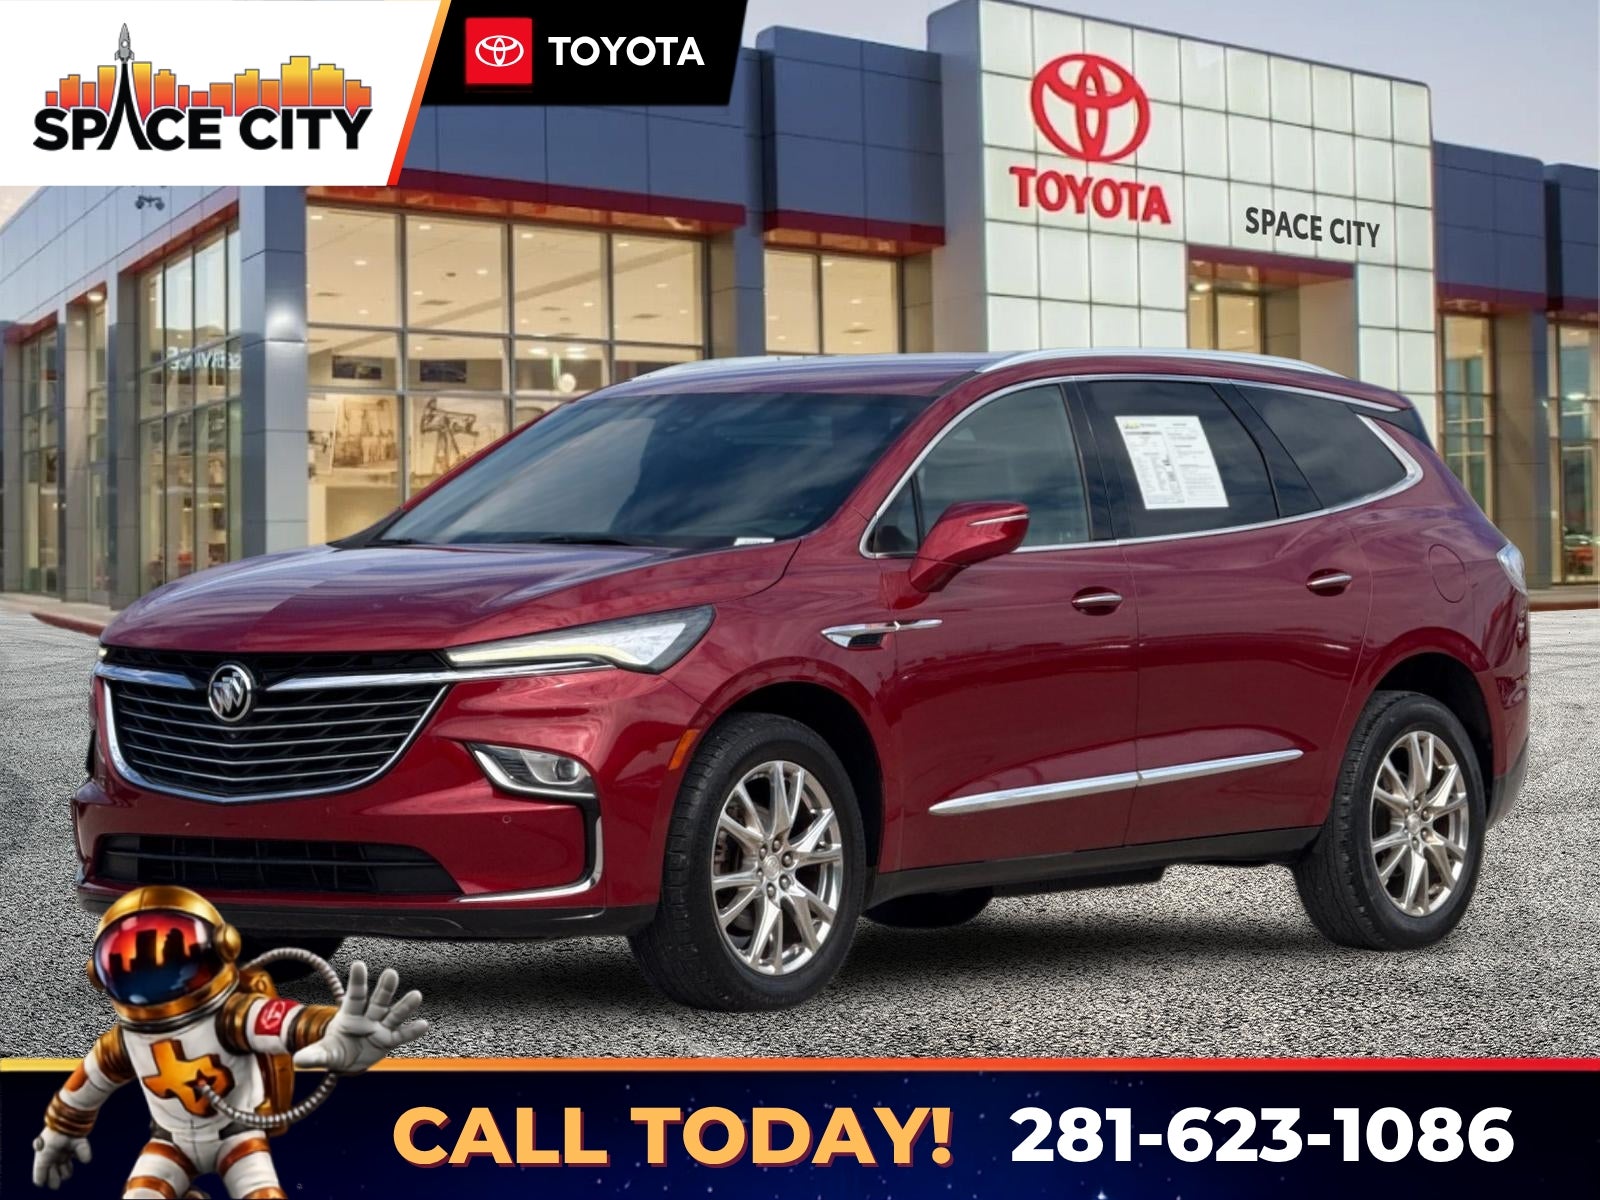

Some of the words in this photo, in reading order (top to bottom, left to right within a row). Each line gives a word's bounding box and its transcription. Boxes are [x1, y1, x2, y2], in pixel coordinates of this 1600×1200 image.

[1009, 166, 1171, 224] TOYOTA
[1245, 206, 1323, 242] SPACE
[1329, 217, 1381, 248] CITY
